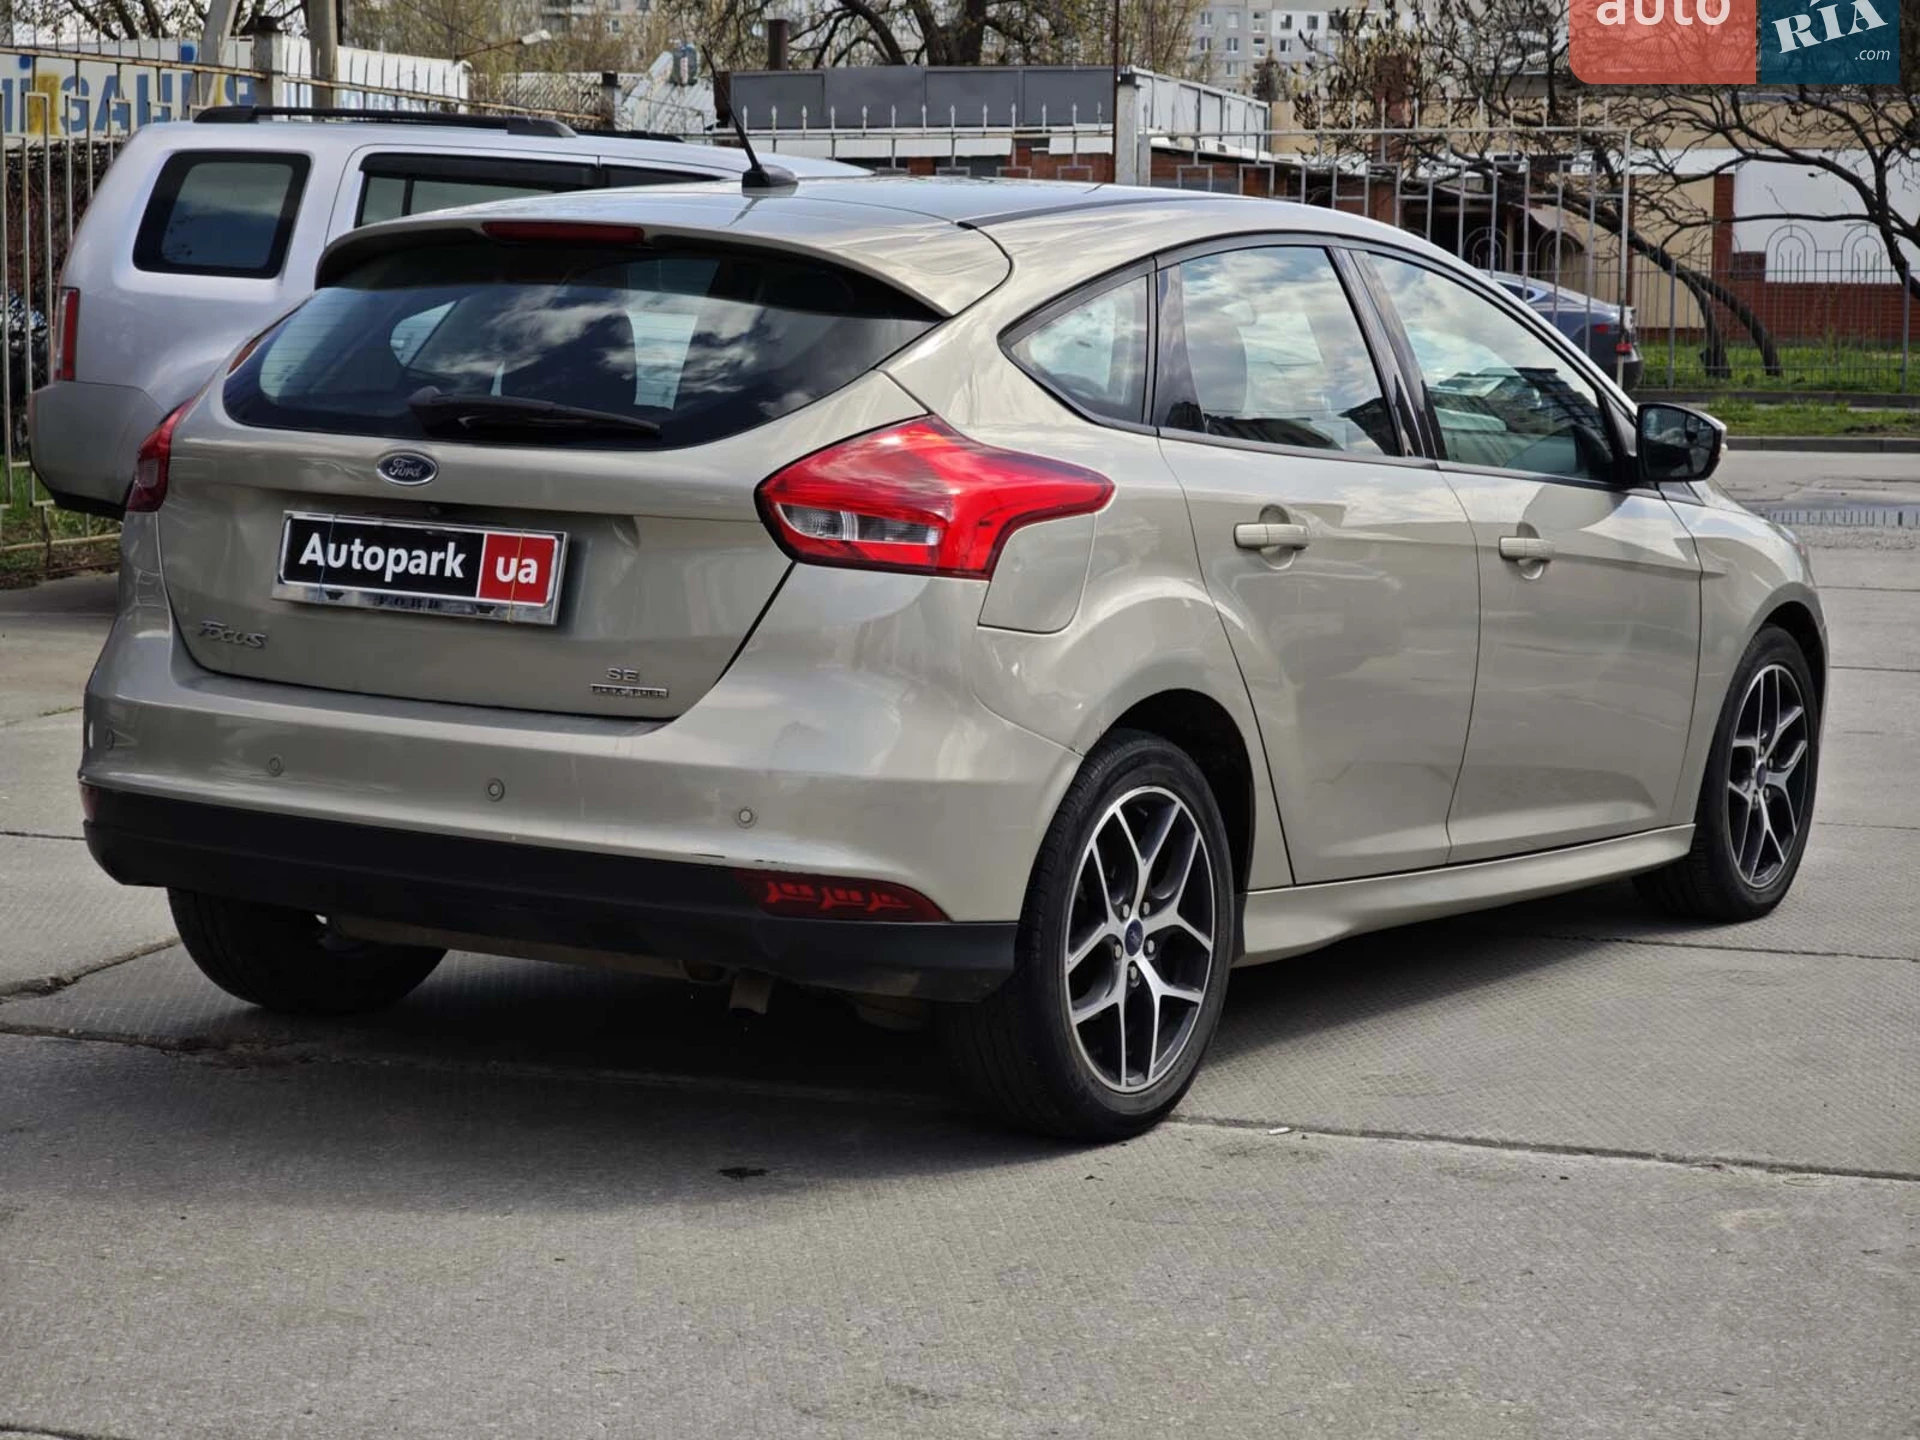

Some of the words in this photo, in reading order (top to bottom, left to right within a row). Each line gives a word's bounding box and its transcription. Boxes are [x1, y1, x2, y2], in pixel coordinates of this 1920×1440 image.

[388, 457, 423, 478] Ford
[299, 532, 467, 583] Autopark
[495, 555, 539, 585] ua
[606, 667, 639, 684] SE
